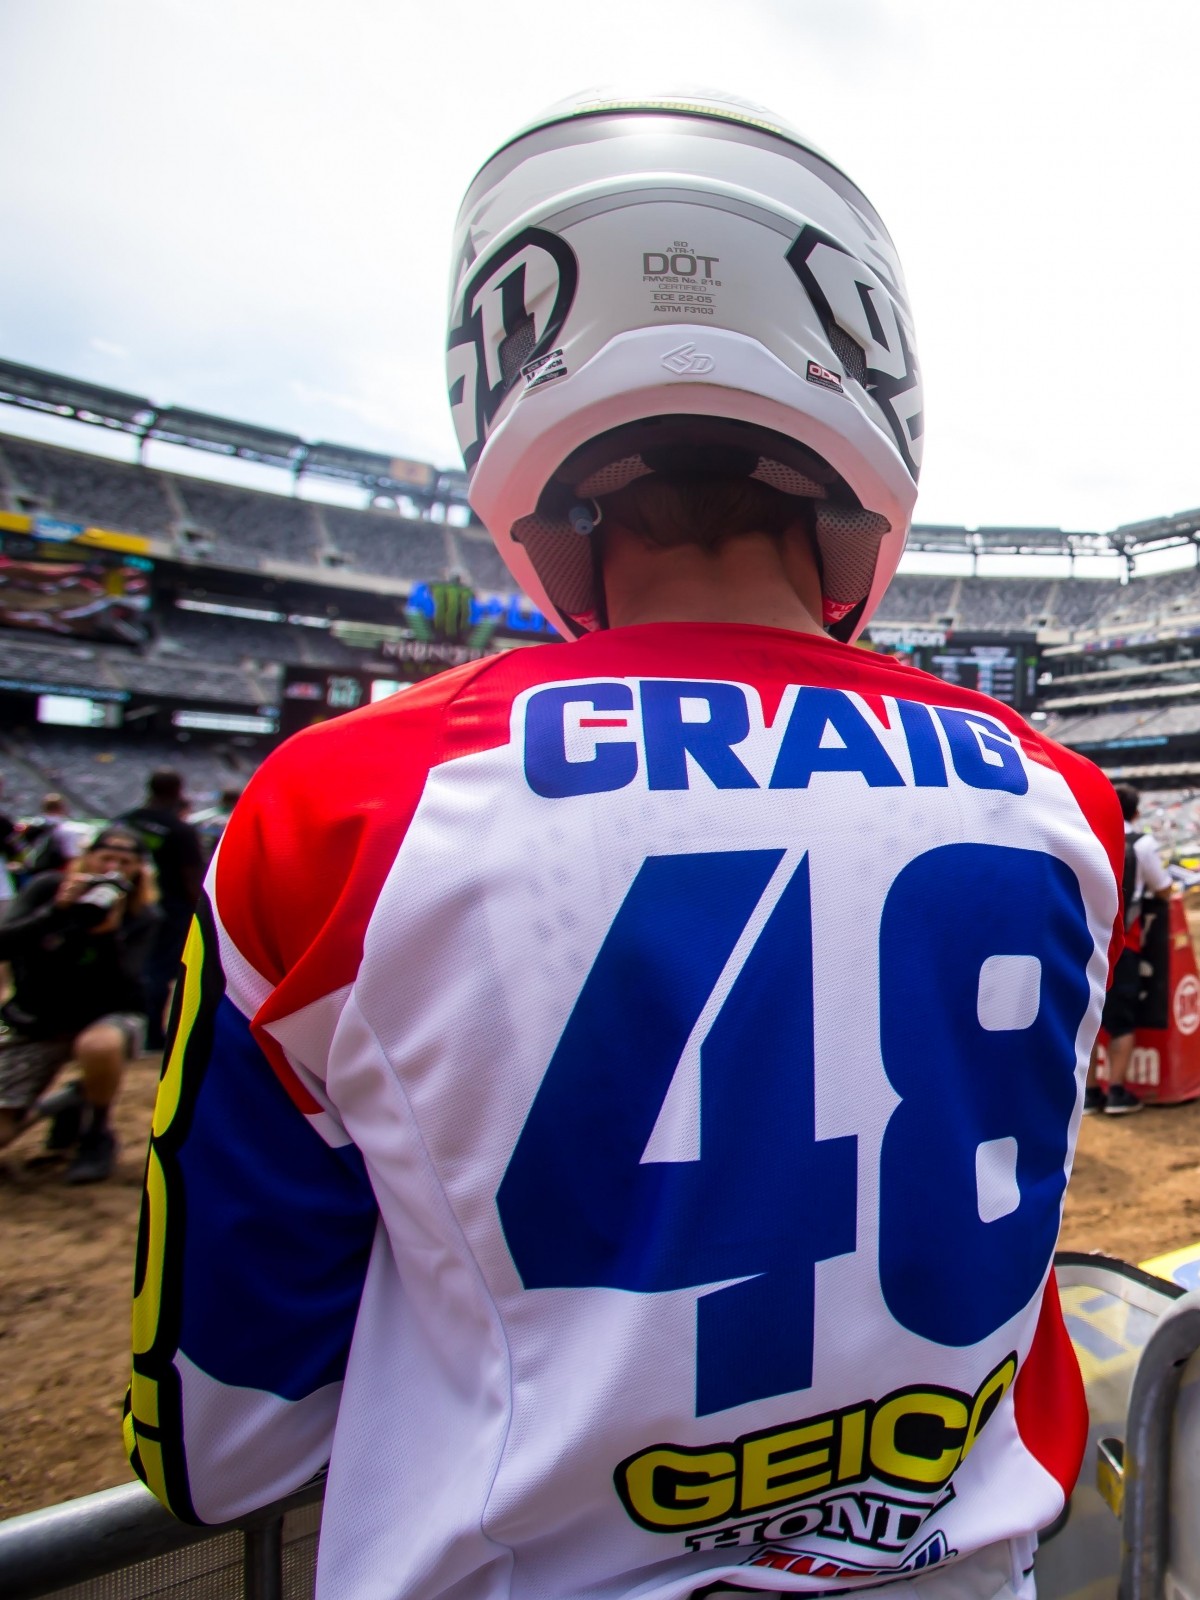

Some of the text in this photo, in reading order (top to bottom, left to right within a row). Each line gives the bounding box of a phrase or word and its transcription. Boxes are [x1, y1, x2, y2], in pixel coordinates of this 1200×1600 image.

[643, 252, 720, 278] DOT
[642, 275, 680, 283] FMVSS
[701, 278, 722, 287] 218
[658, 283, 707, 292] CERTIFIED
[653, 293, 713, 304] ECE 22-05
[653, 305, 714, 315] ASTM F3103
[524, 680, 1029, 799] CRAIG
[495, 842, 1094, 1418] 48
[688, 1486, 955, 1553] HOND
